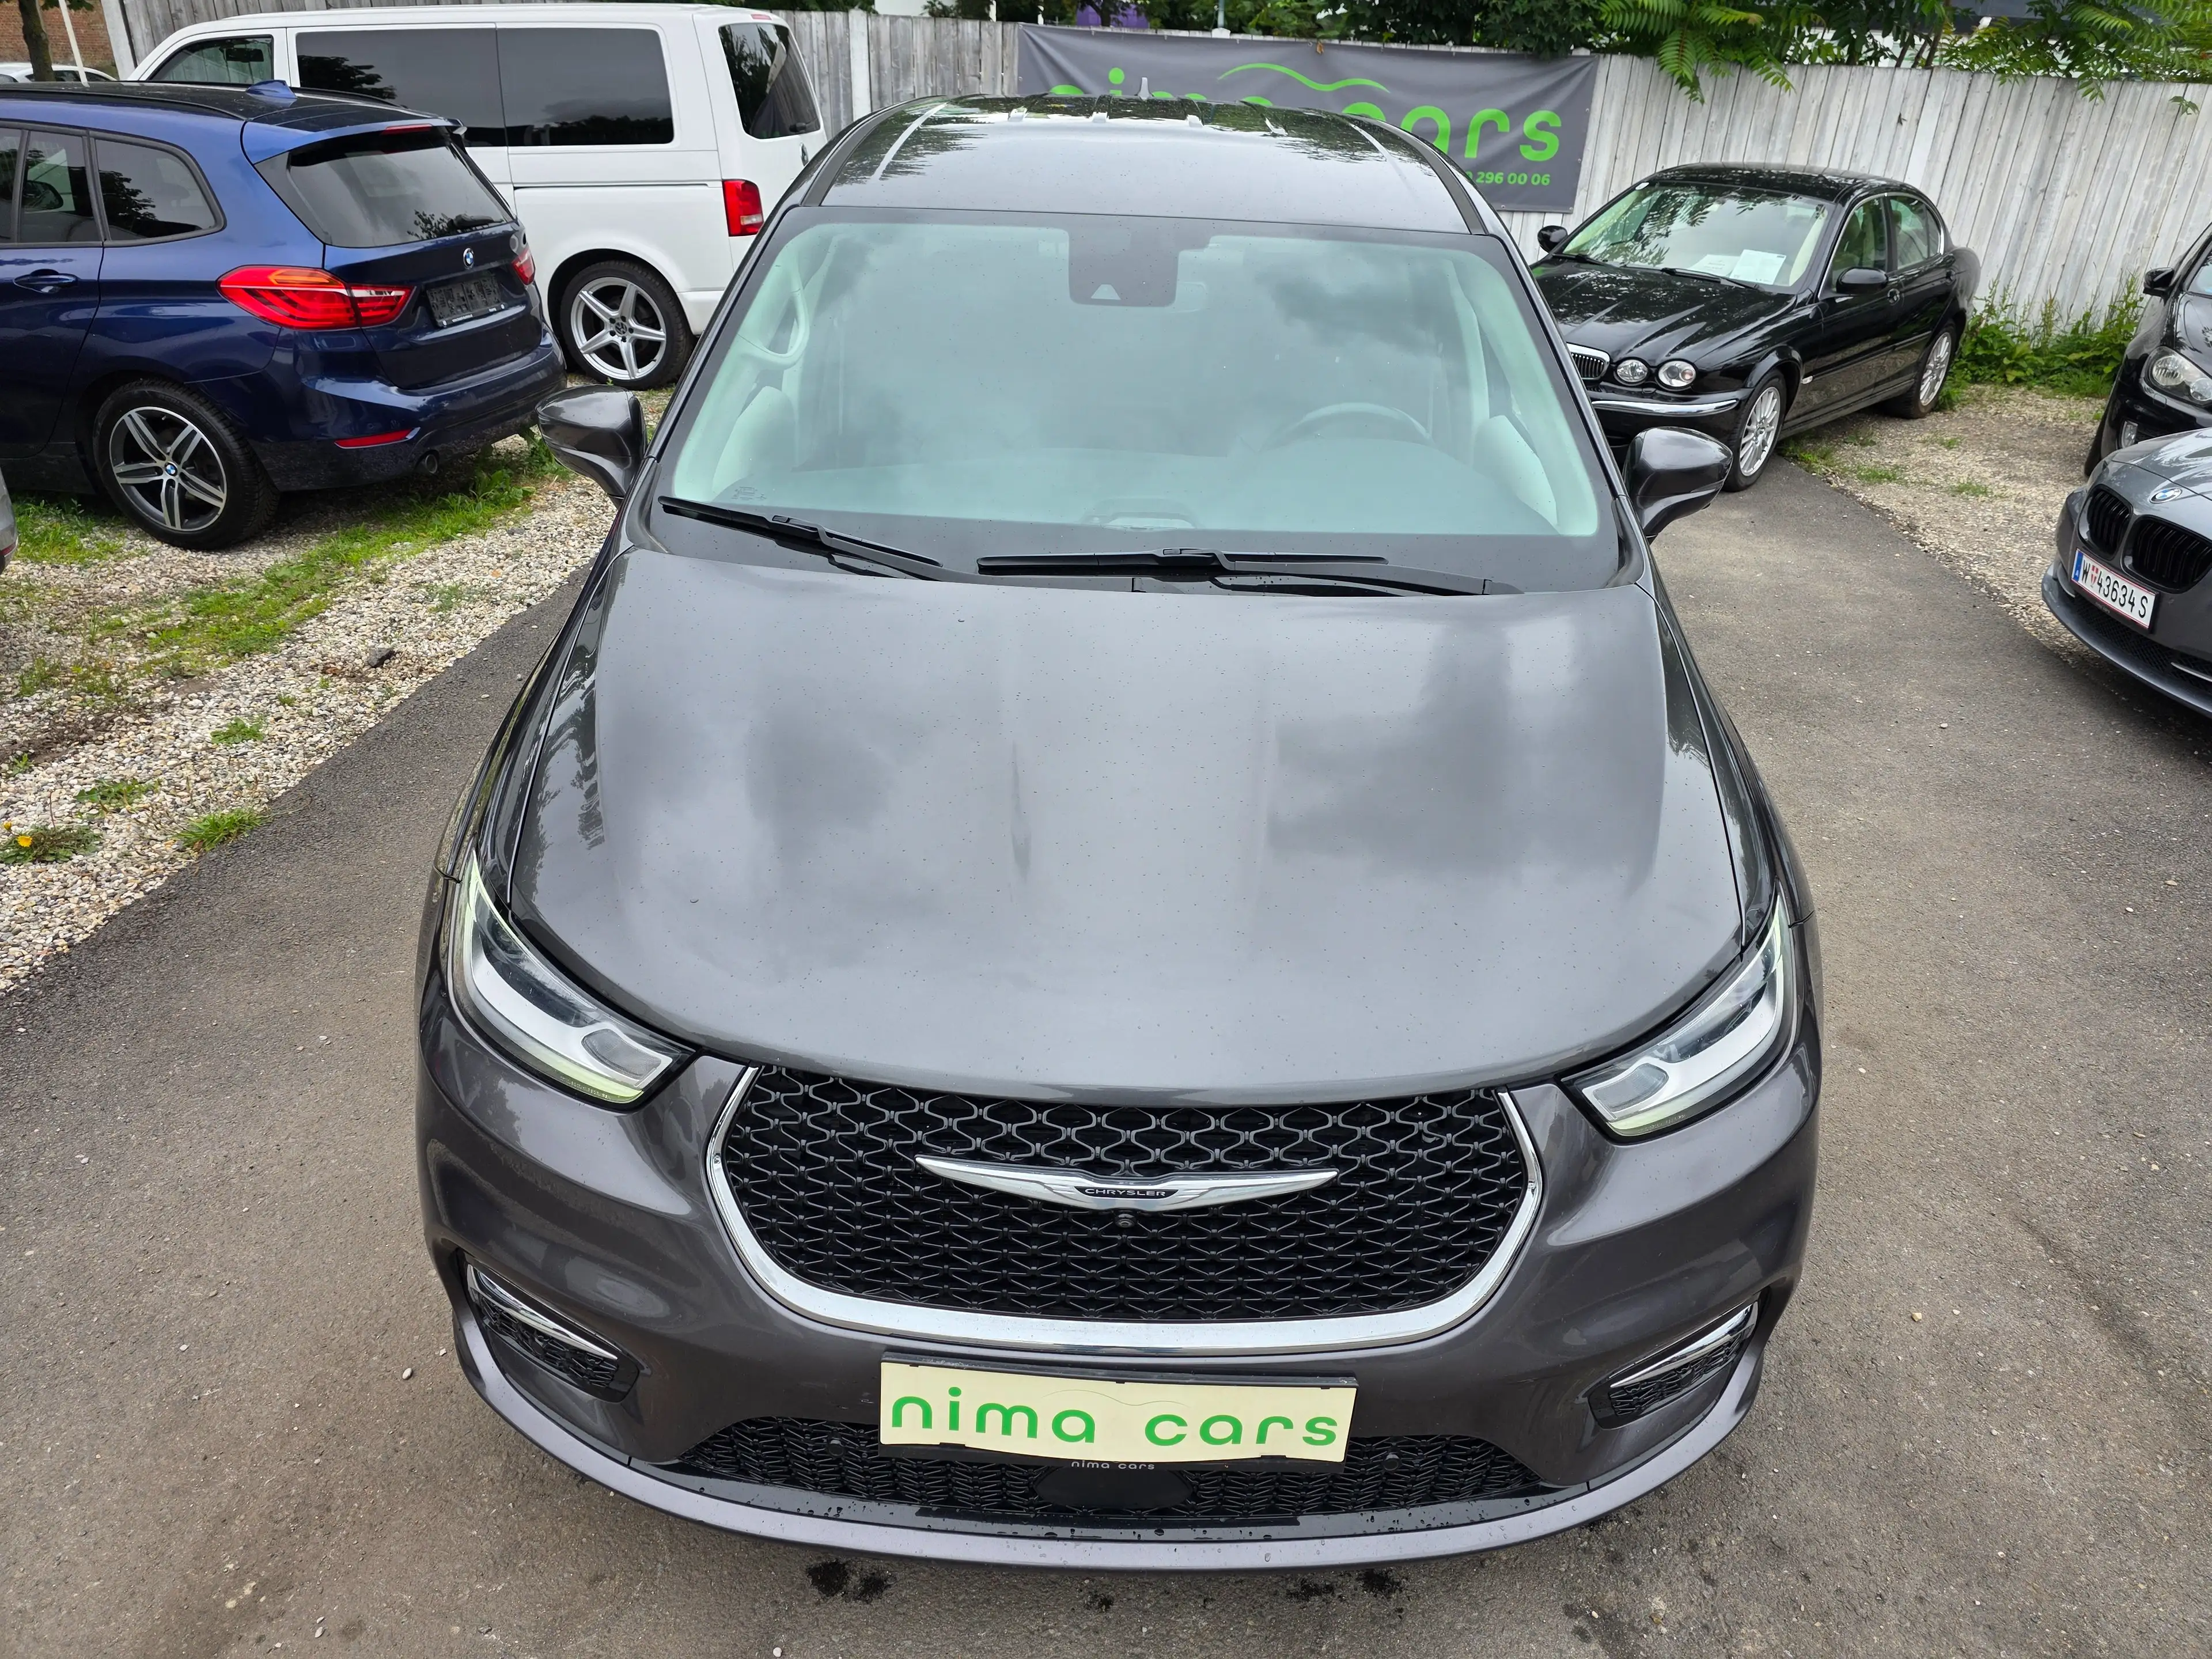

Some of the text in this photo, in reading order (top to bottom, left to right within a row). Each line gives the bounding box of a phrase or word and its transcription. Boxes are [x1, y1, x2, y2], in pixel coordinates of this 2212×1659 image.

[1342, 102, 1562, 161] ars
[1476, 171, 1504, 184] 296
[1507, 172, 1528, 184] 00
[1531, 173, 1550, 185] 06
[2097, 571, 2135, 613] 43634
[2138, 595, 2148, 618] S
[1085, 1188, 1166, 1196] CHRYSLER
[892, 1387, 1338, 1446] nima cars
[1071, 1460, 1110, 1469] nima
